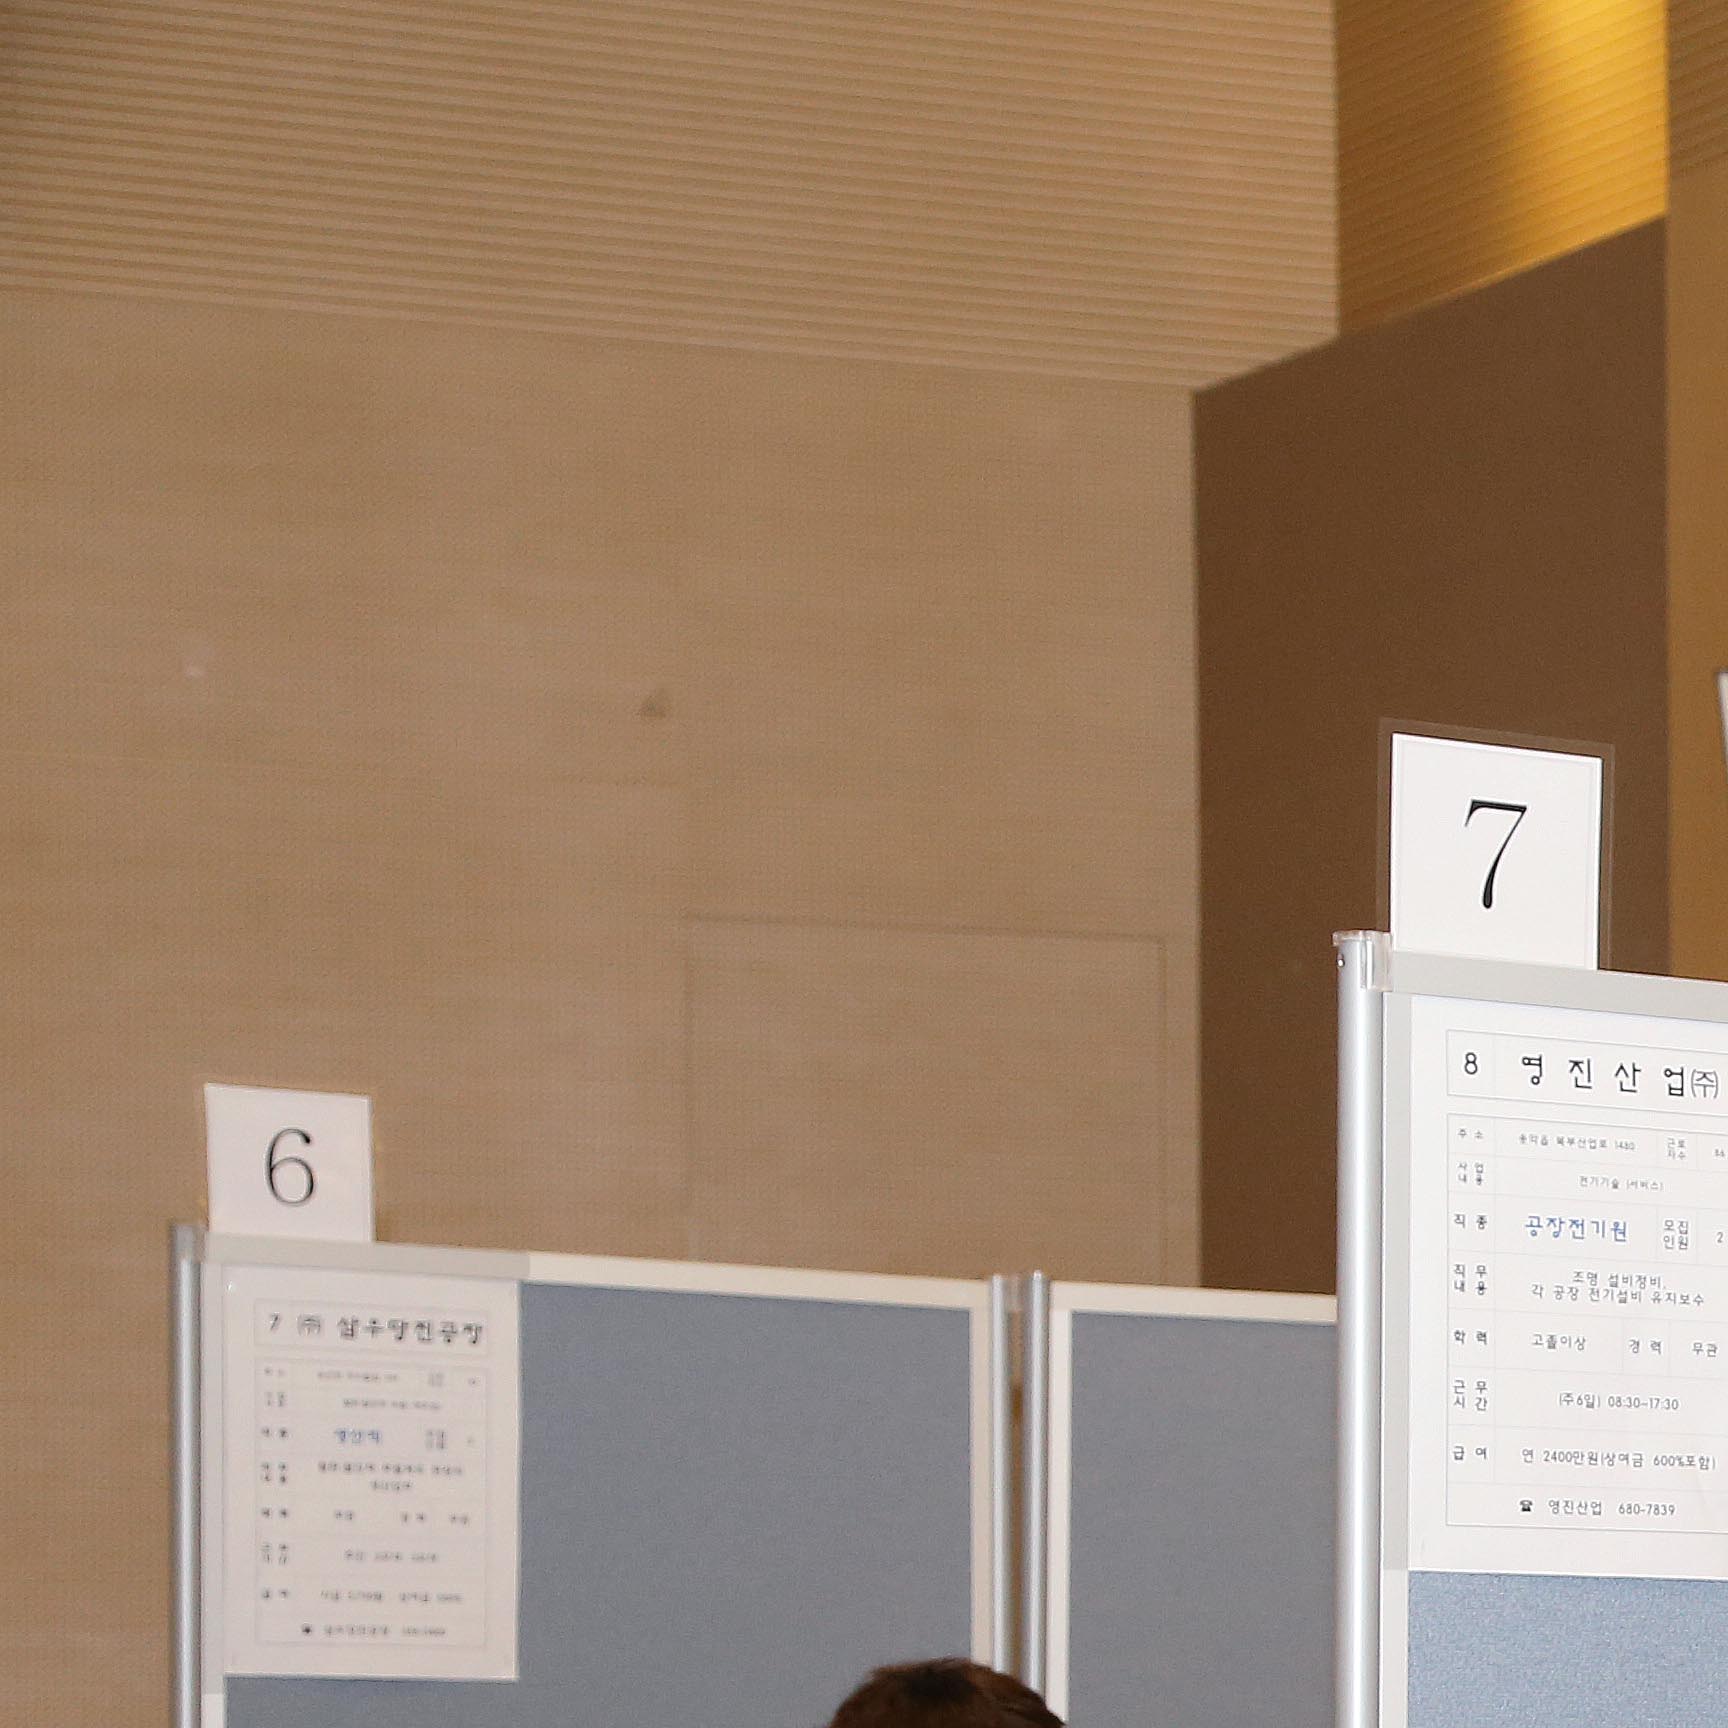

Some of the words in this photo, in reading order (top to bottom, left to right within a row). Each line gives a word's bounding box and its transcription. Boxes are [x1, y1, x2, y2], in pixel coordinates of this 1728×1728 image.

[1464, 799, 1527, 909] 7
[1463, 1052, 1478, 1075] 8
[266, 1127, 315, 1206] 6
[1454, 1213, 1487, 1230] 직종
[1525, 1215, 1628, 1243] 공장전기원
[1663, 1219, 1689, 1234] 모집
[1663, 1235, 1689, 1250] 인원
[1717, 1231, 1724, 1244] 2
[1454, 1264, 1487, 1277] 직무
[1573, 1271, 1599, 1286] 조명
[1454, 1279, 1487, 1296] 내용
[1532, 1284, 1544, 1298] 각
[1553, 1285, 1579, 1301] 공장
[1588, 1288, 1642, 1304] 전기설비
[1650, 1290, 1705, 1306] 유지보수
[1453, 1330, 1487, 1346] 학력
[1532, 1334, 1587, 1351] 고졸이상
[1628, 1339, 1662, 1354] 경력
[1693, 1342, 1718, 1358] 무관
[1453, 1379, 1487, 1394] 근무
[1453, 1396, 1487, 1412] 시간
[1558, 1392, 1600, 1410] (주6일)
[1453, 1446, 1487, 1461] 급여
[1522, 1449, 1534, 1463] 연
[1543, 1450, 1644, 1468] 2400만원(상여금
[1653, 1455, 1716, 1470] 600%포함)
[1549, 1499, 1602, 1516] 영진산업
[1619, 1503, 1675, 1517] 680-7839
